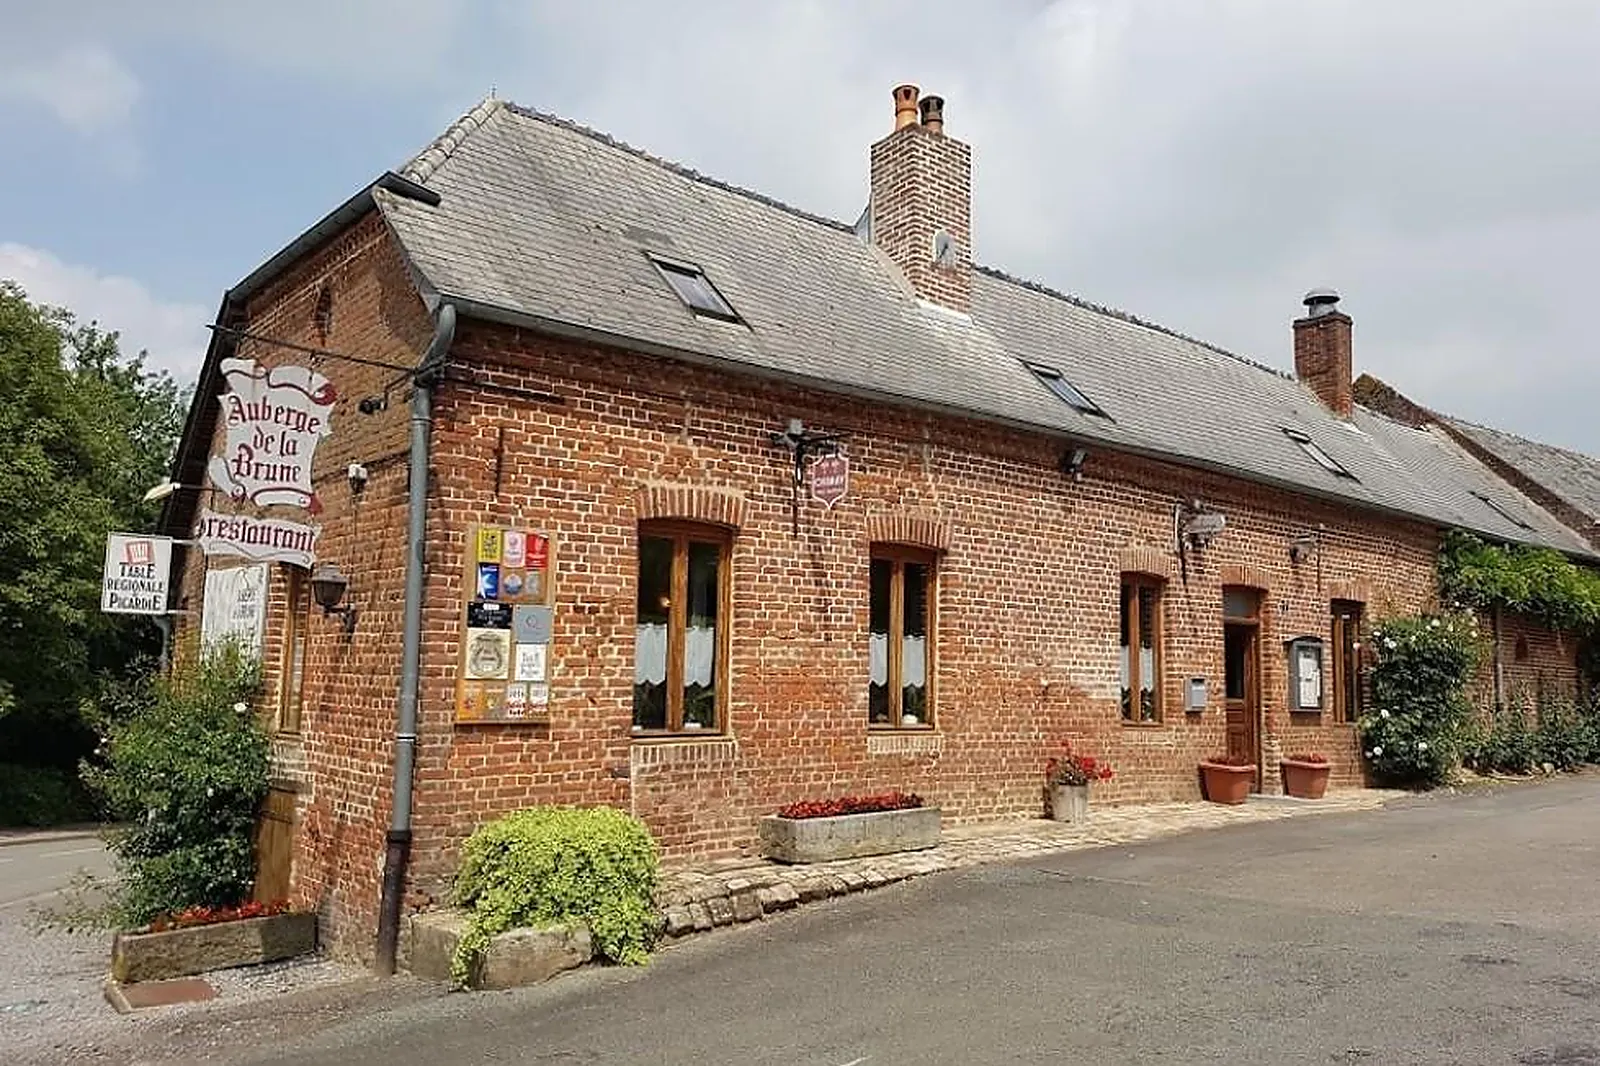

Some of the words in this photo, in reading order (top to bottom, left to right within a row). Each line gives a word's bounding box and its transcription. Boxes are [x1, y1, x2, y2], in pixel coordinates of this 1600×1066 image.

[228, 395, 320, 434] Auberge
[253, 425, 275, 454] de
[280, 430, 298, 457] la
[231, 443, 301, 482] Brune
[206, 518, 315, 552] restaurant
[119, 562, 155, 579] TABLE
[108, 592, 162, 610] PICARDIE
